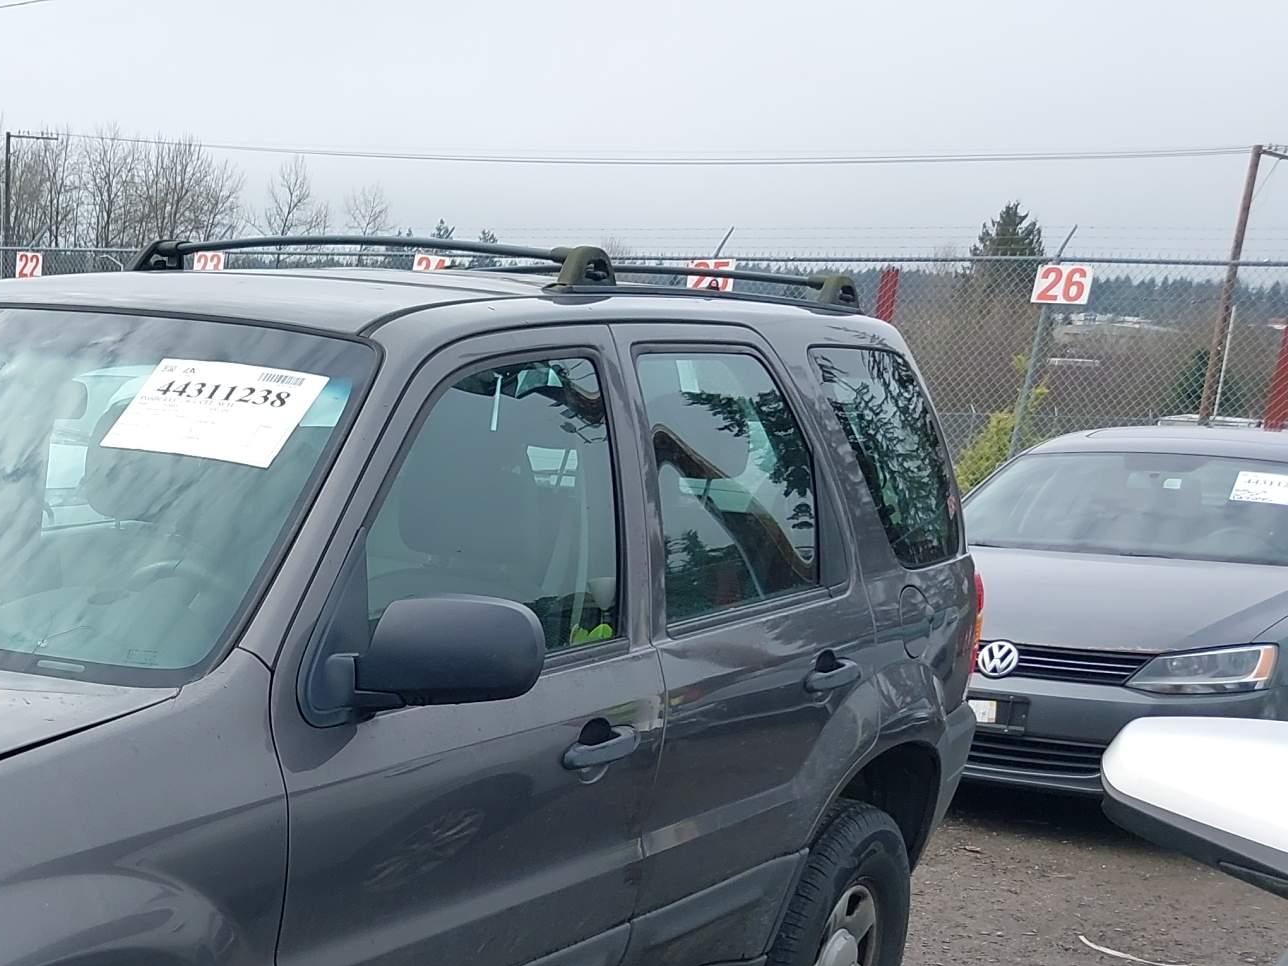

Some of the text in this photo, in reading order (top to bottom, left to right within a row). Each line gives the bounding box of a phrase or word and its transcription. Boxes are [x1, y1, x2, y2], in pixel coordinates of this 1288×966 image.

[18, 254, 40, 278] 22
[1036, 266, 1087, 303] 26
[156, 379, 291, 408] 44311238
